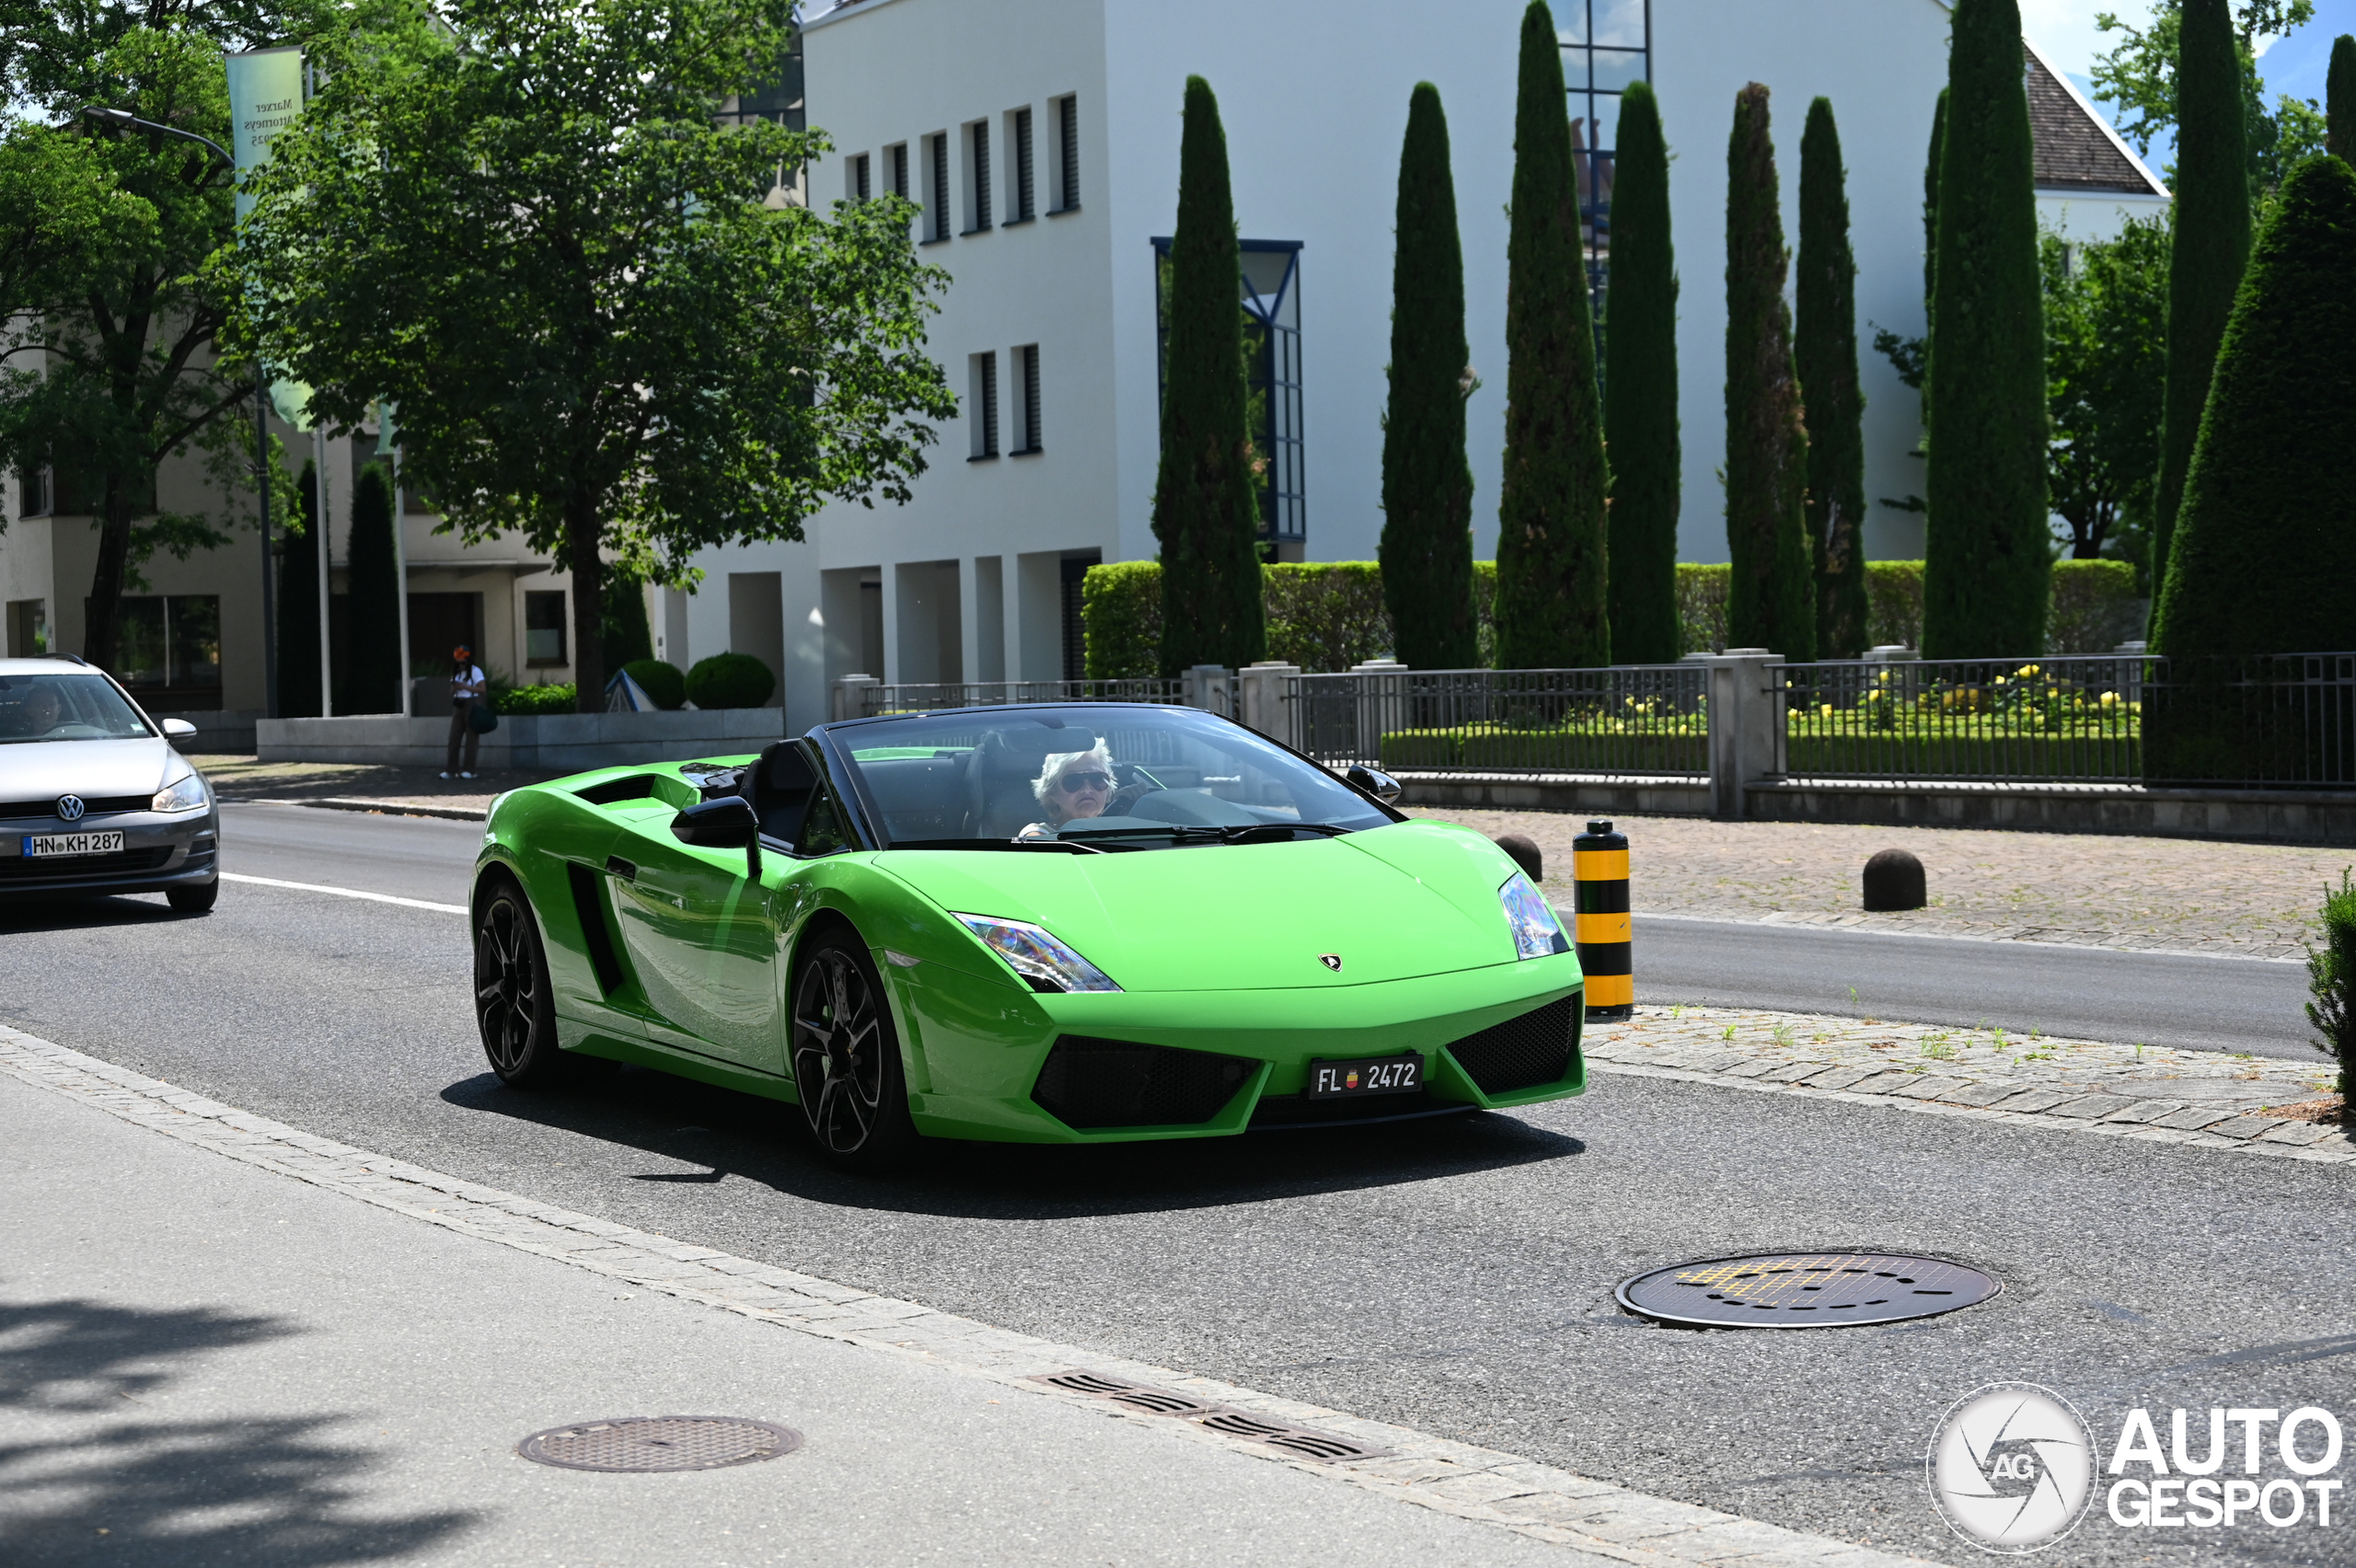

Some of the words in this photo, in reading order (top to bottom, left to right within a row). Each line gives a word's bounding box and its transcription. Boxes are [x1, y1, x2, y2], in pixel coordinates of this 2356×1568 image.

[33, 836, 55, 854] HN
[66, 835, 88, 852] KH
[91, 833, 121, 850] 287
[1318, 1068, 1342, 1092] FL
[1367, 1063, 1415, 1089] 2472
